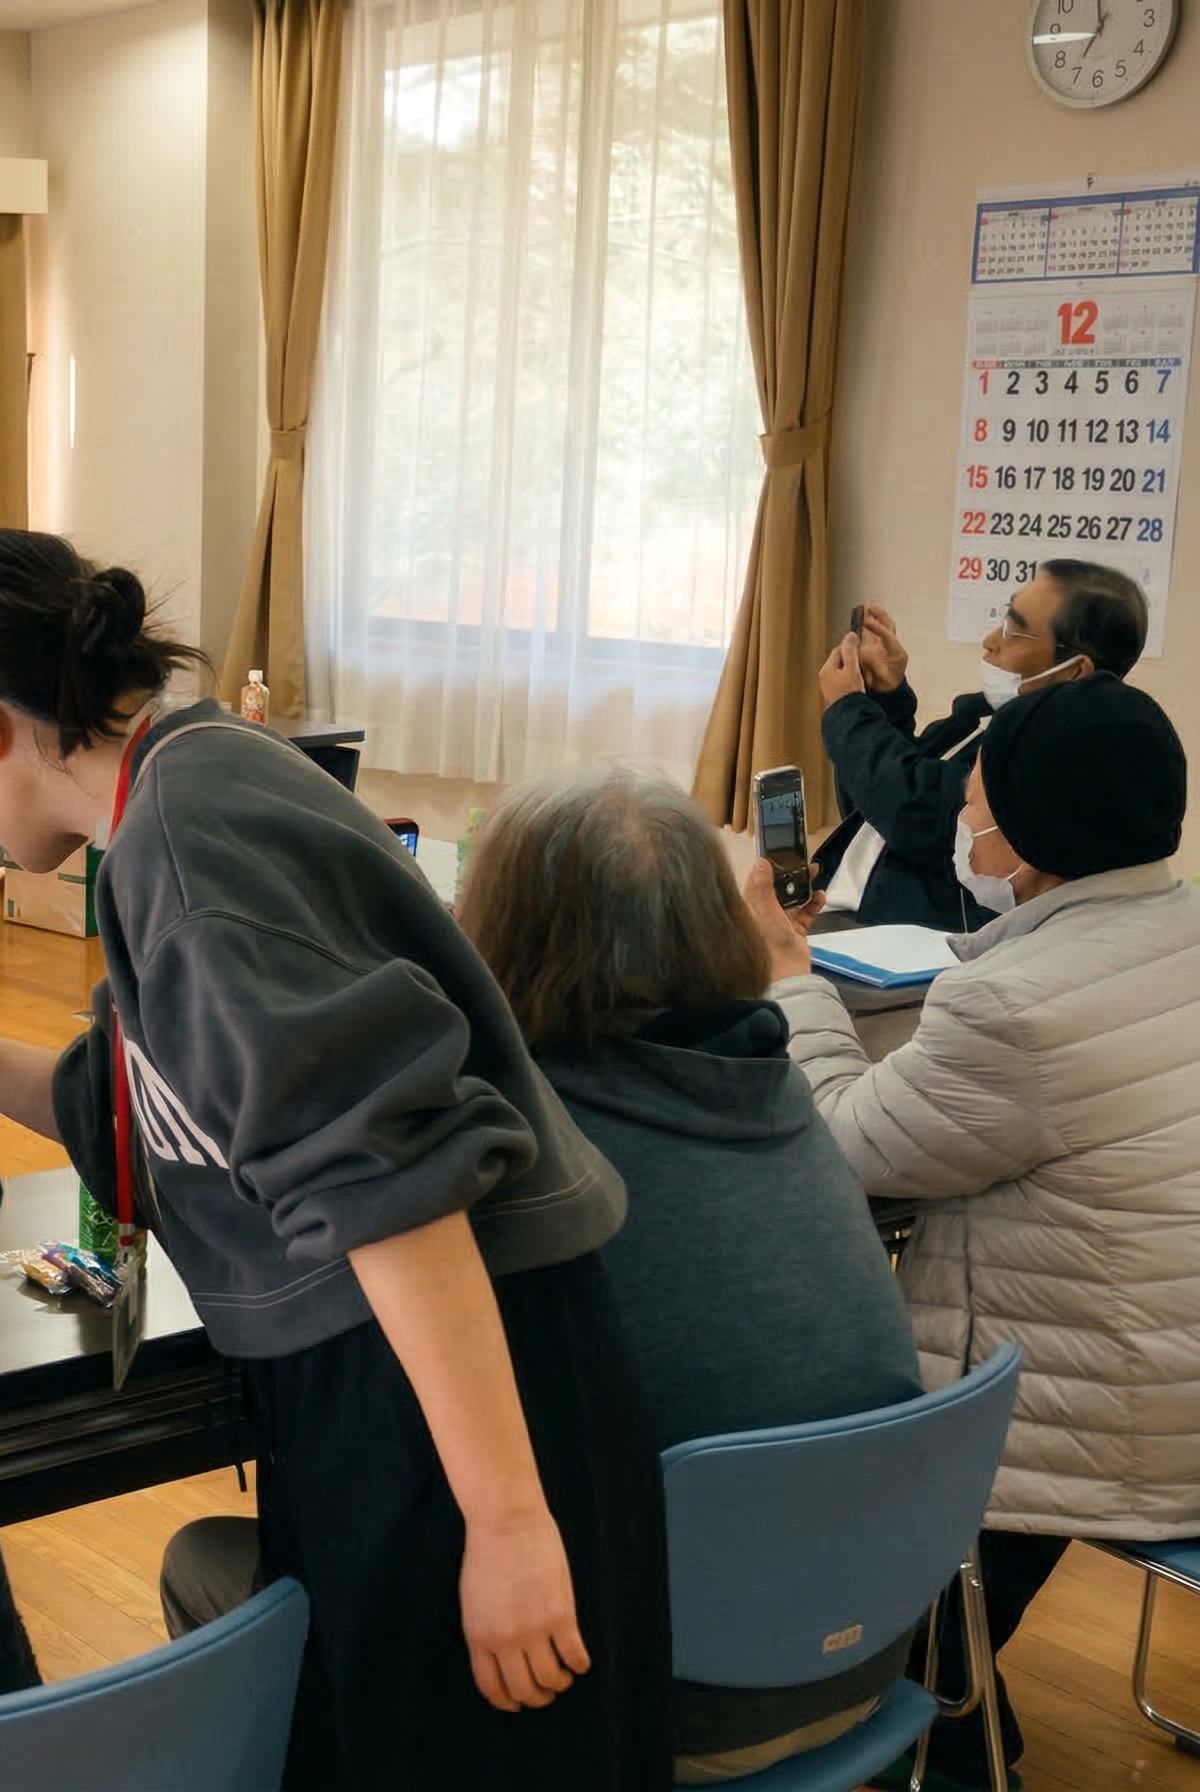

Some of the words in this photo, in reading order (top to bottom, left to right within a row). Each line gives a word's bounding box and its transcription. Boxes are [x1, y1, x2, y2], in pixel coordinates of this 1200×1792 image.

[1143, 9, 1155, 27] 3
[1132, 38, 1145, 56] 4
[1054, 50, 1066, 69] 8
[1114, 60, 1127, 78] 5
[1071, 66, 1083, 85] 7
[1091, 70, 1104, 88] 6
[1057, 300, 1098, 345] 12
[979, 370, 989, 394] 1
[1006, 371, 1020, 394] 2
[1035, 371, 1048, 394] 3
[1064, 371, 1078, 394] 4
[1095, 371, 1109, 394] 5
[1125, 370, 1139, 394] 6
[1157, 369, 1171, 394] 7
[975, 418, 988, 442] 8
[1003, 419, 1016, 442] 9
[1026, 419, 1049, 442] 10
[1058, 419, 1077, 442] 11
[1086, 419, 1108, 443] 12
[1116, 419, 1139, 443] 13
[1146, 419, 1170, 443] 14
[966, 465, 988, 488] 15
[995, 466, 1016, 489] 16
[1024, 467, 1046, 489] 17
[1052, 467, 1074, 490] 18
[1082, 468, 1105, 491] 19
[1110, 468, 1135, 492] 20
[1142, 469, 1166, 493] 21
[961, 512, 986, 534] 22
[990, 513, 1014, 536] 23
[1018, 514, 1042, 537] 24
[1047, 515, 1071, 538] 25
[1076, 516, 1101, 539] 26
[1106, 517, 1133, 540] 27
[1136, 518, 1163, 542] 28
[958, 557, 982, 579] 29
[986, 559, 1010, 580] 30
[1015, 560, 1037, 582] 31
